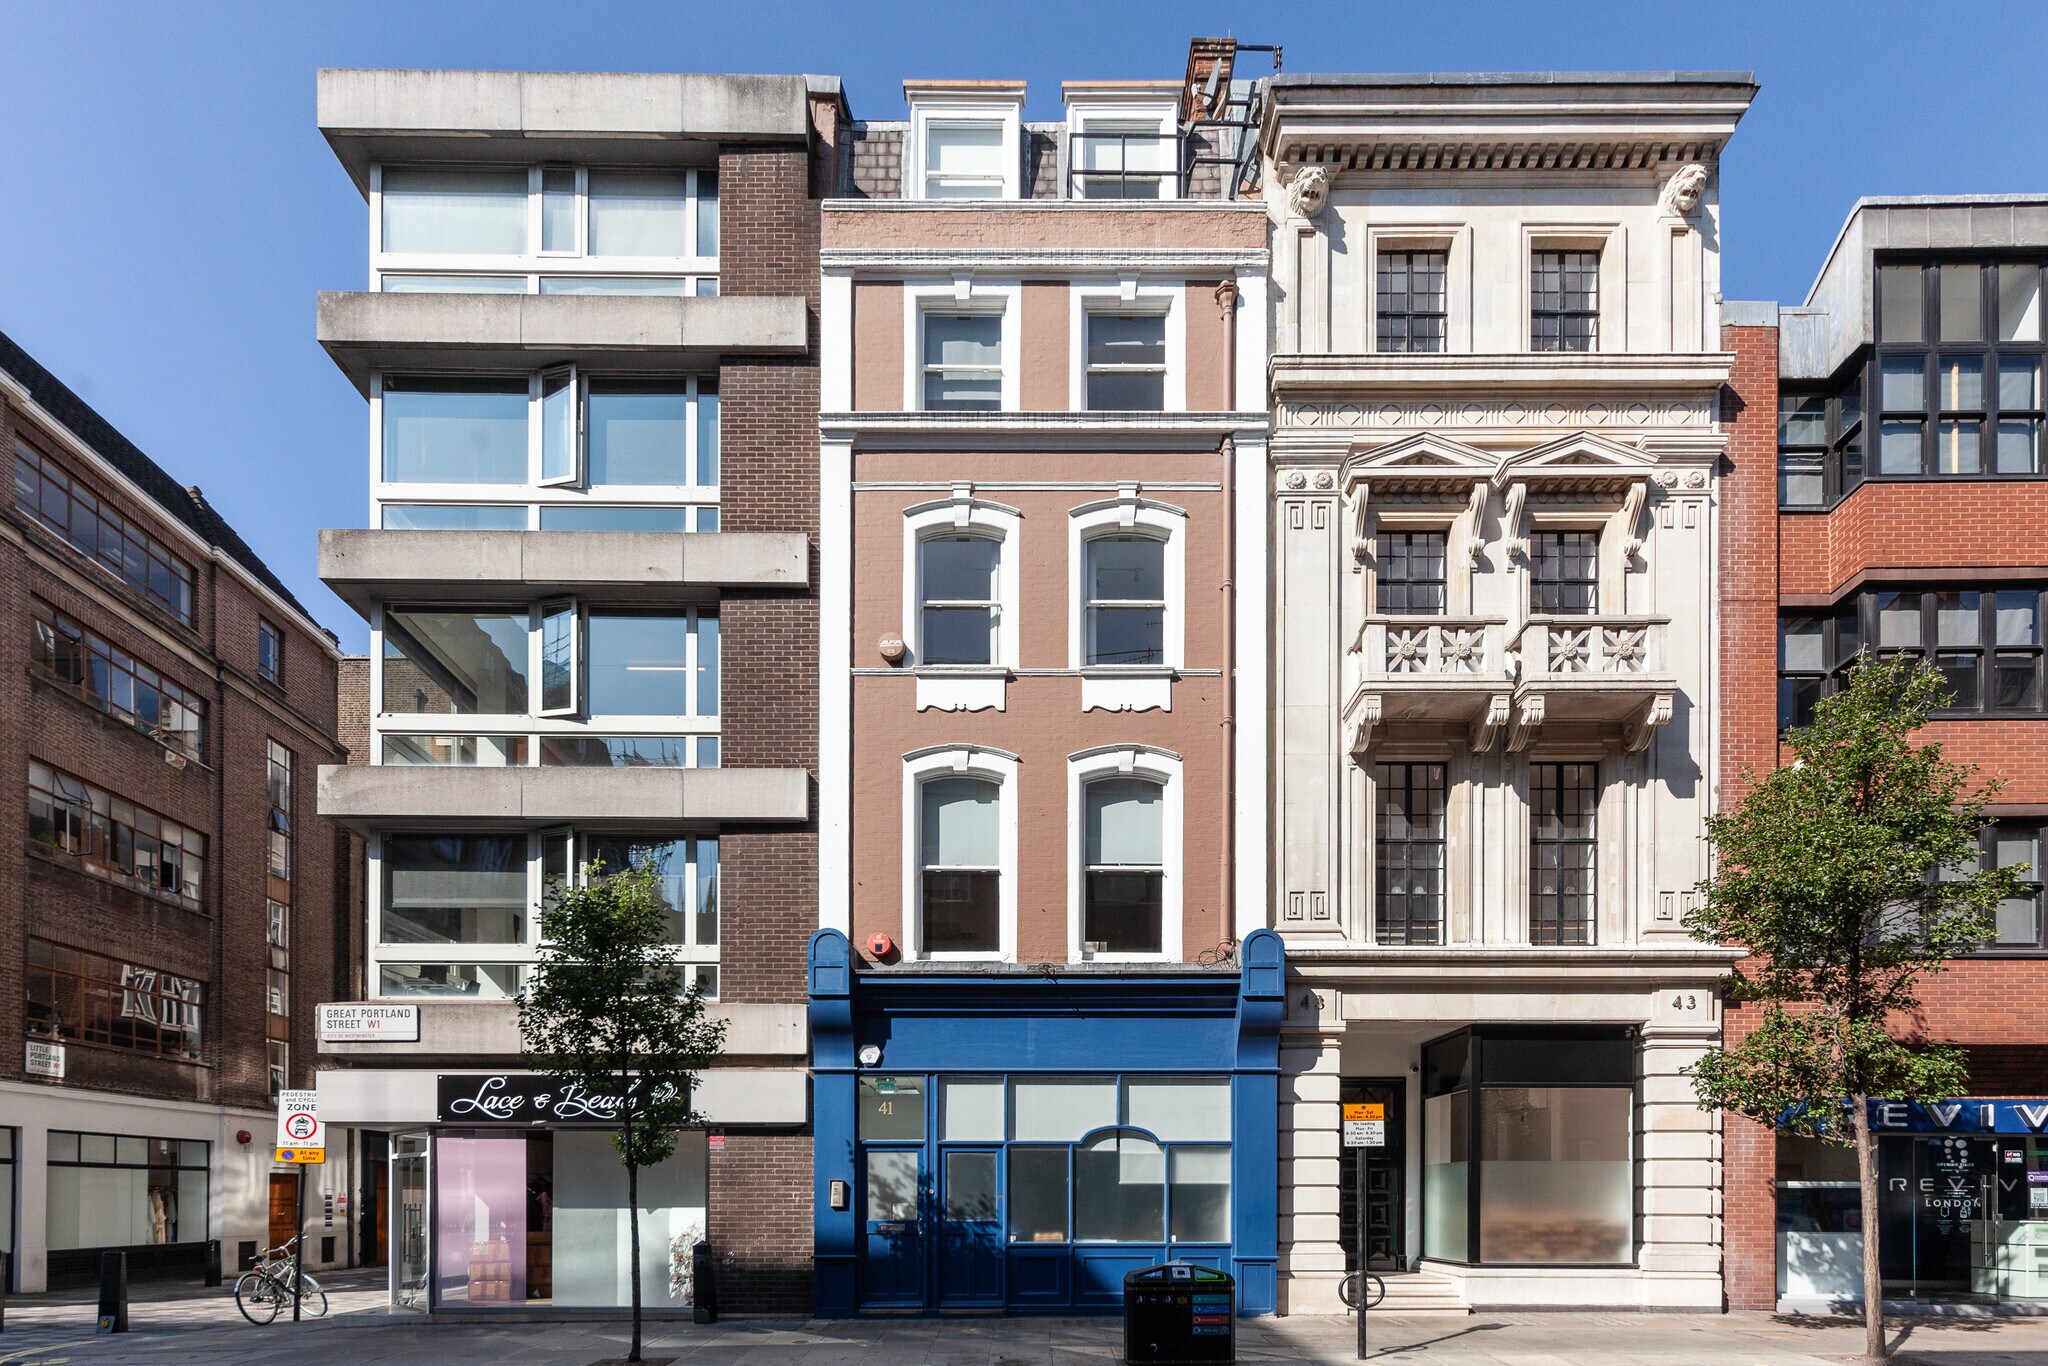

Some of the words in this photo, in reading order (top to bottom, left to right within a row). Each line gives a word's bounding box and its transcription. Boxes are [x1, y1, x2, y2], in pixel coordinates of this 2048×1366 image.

[1300, 994, 1325, 1010] 43
[1672, 995, 1696, 1010] 43
[327, 1009, 356, 1018] GREAT
[361, 1009, 410, 1018] PORTLAND
[327, 1020, 361, 1029] STREET
[367, 1020, 380, 1029] W1
[30, 1045, 50, 1053] LITTLE
[30, 1052, 60, 1062] PORTLAND
[30, 1060, 51, 1068] STREET
[451, 1077, 525, 1118] Lace
[534, 1094, 550, 1109] &
[878, 1101, 893, 1115] 41
[1843, 1103, 2048, 1128] EVIV
[1889, 1178, 2018, 1192] REVV
[1926, 1199, 1981, 1207] LONDON
